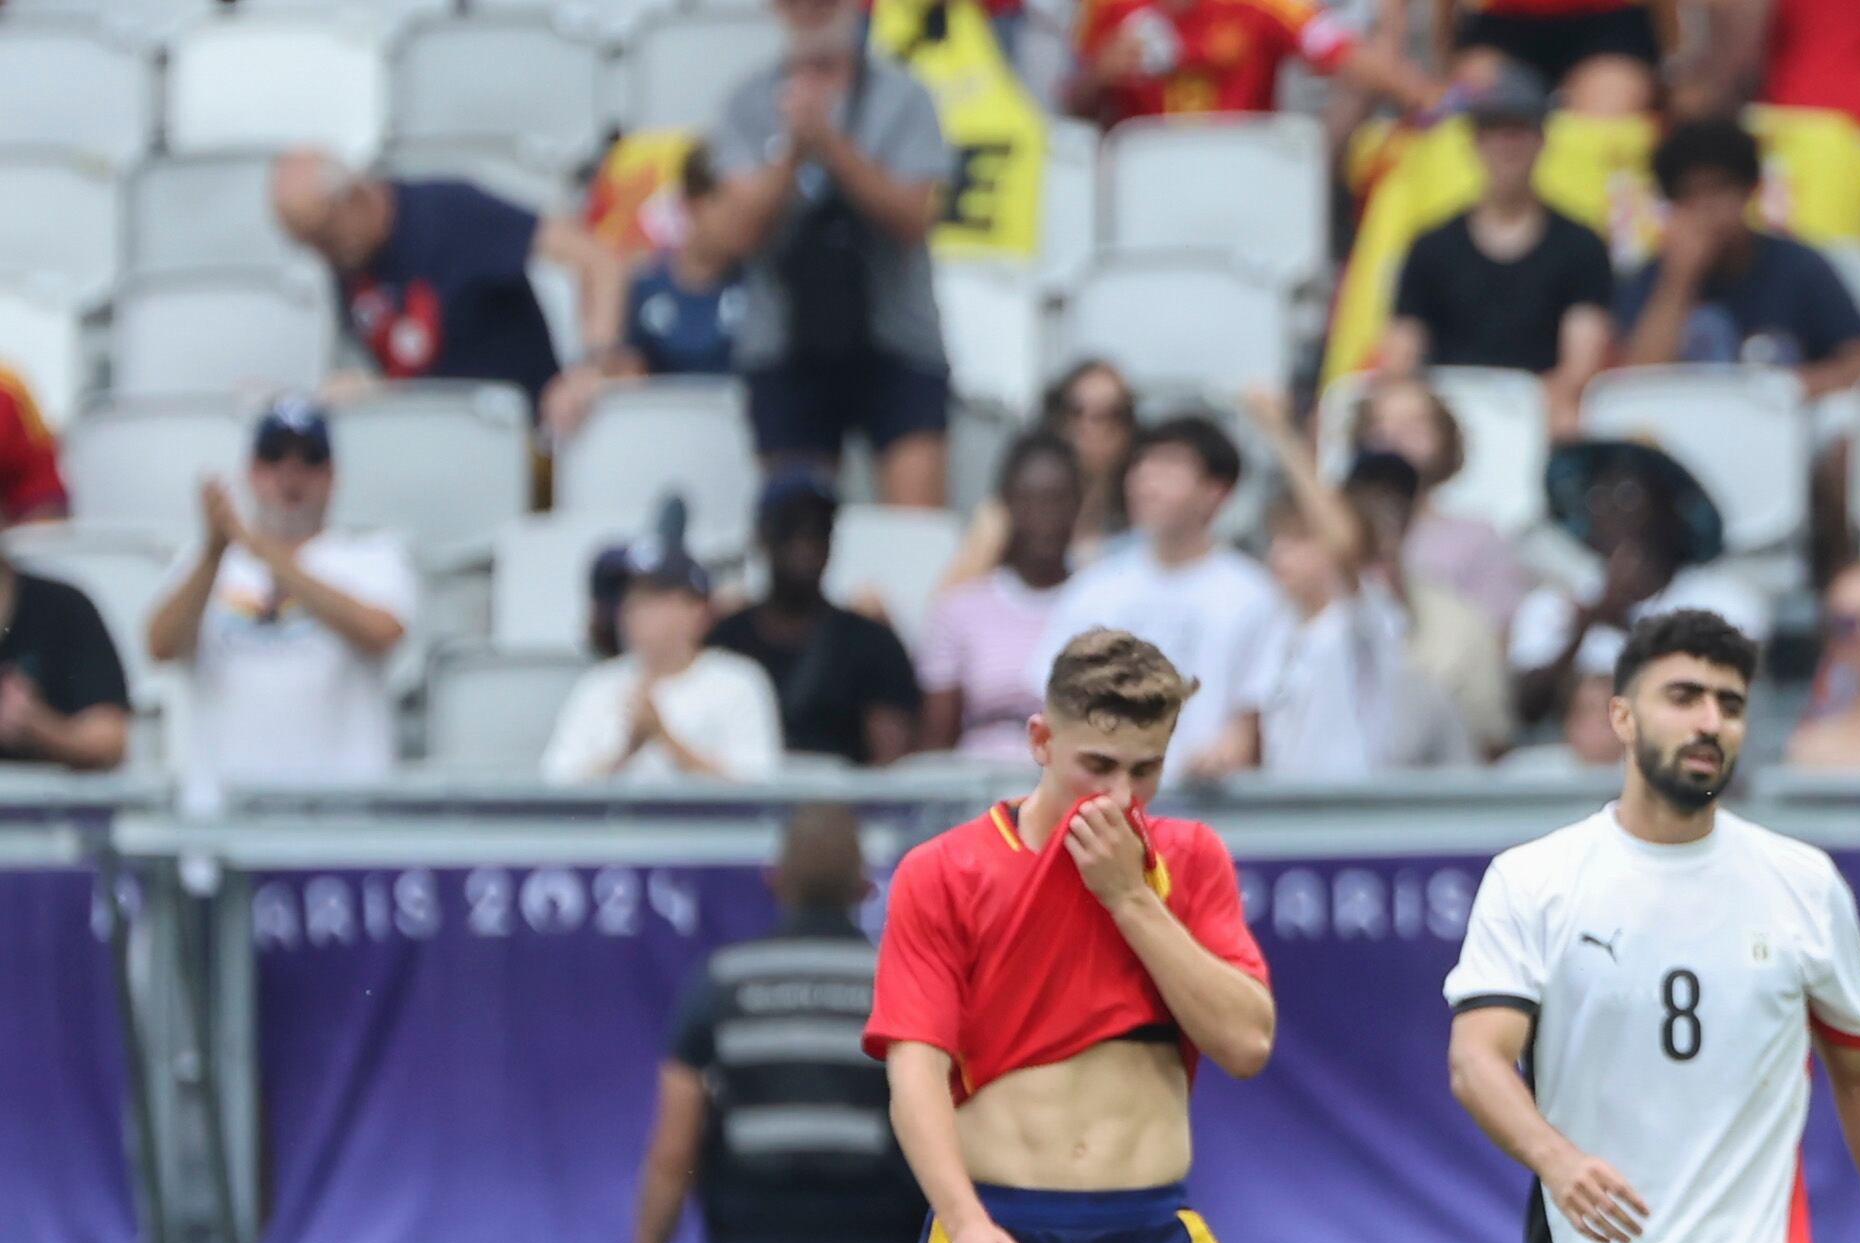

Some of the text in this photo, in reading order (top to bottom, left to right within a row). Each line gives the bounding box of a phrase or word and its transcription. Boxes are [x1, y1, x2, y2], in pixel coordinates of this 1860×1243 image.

[250, 863, 699, 948] ARIS 2024
[1660, 967, 1702, 1062] 8
